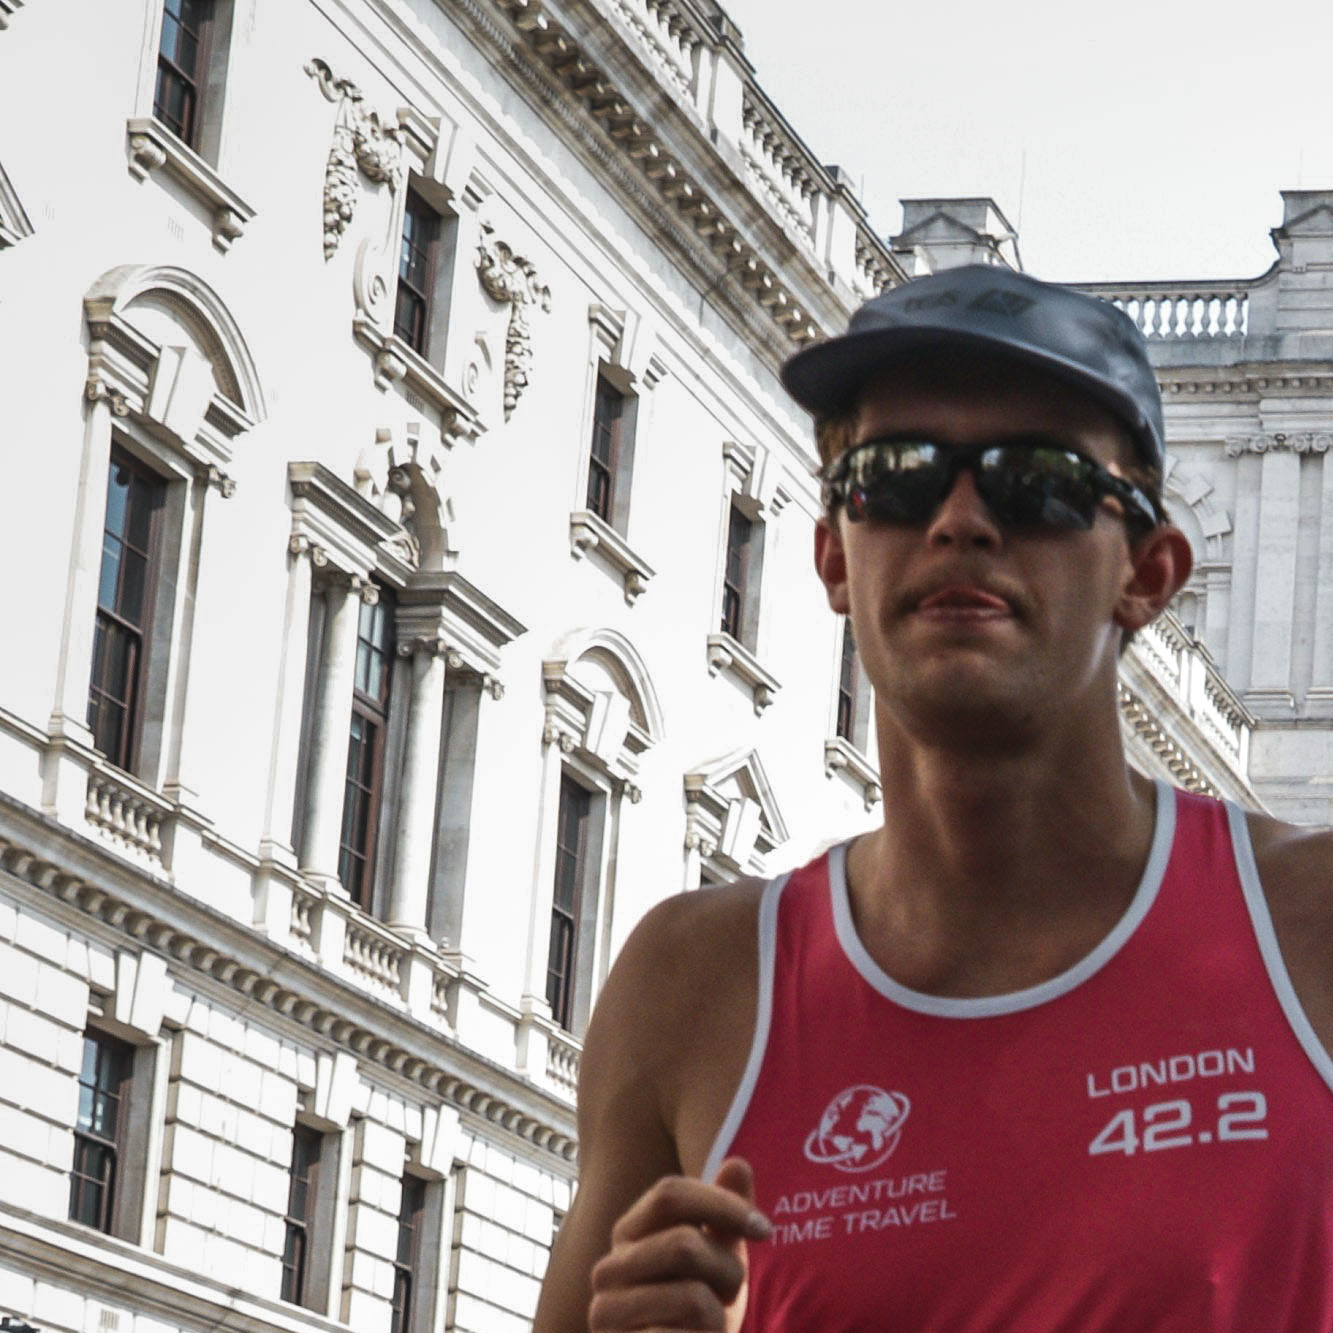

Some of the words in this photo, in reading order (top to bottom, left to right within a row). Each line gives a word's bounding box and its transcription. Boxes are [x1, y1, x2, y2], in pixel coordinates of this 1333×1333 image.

[1087, 1049, 1254, 1097] LONDON
[1088, 1091, 1268, 1156] 42.2
[774, 1170, 947, 1216] ADVENTURE
[771, 1213, 832, 1248] TIME
[844, 1200, 956, 1236] TRAVEL
